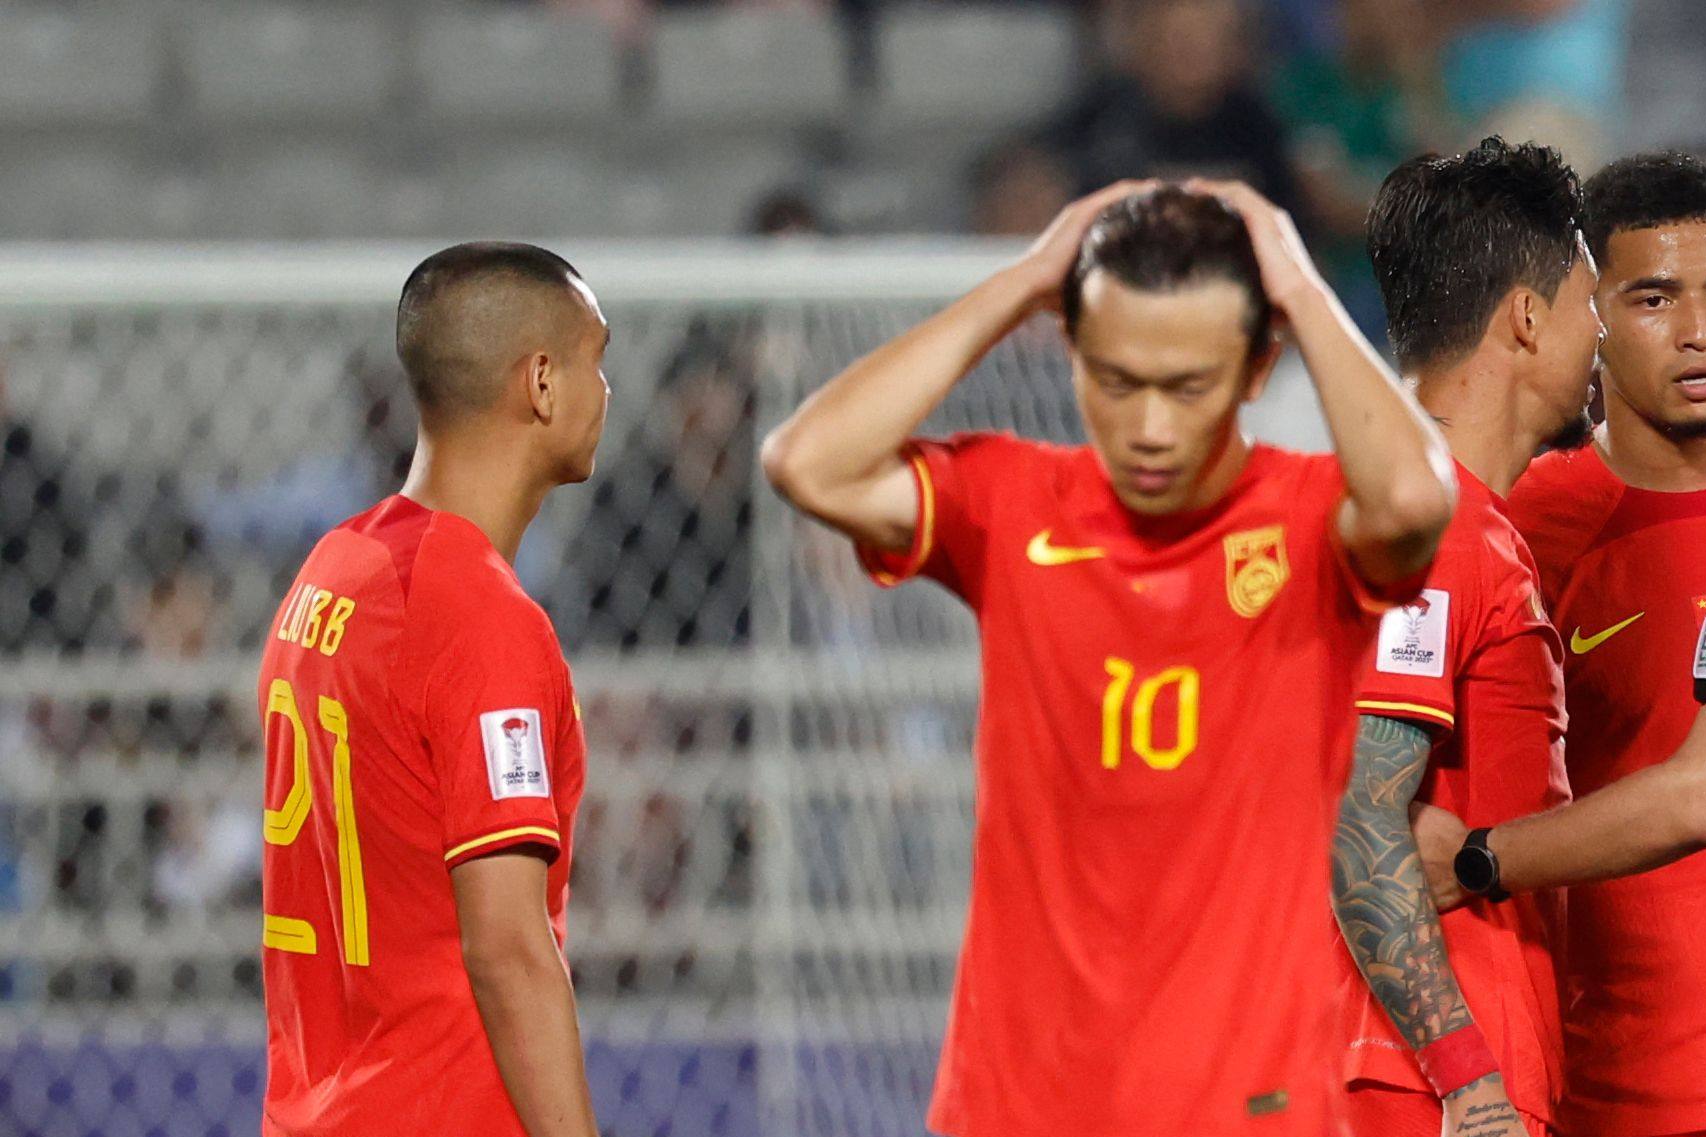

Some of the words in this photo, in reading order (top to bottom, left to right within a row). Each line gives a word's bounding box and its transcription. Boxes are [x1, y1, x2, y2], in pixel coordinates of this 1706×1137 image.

[1390, 647, 1416, 656] ASIAN
[1417, 649, 1434, 659] CUP
[1102, 656, 1199, 770] 10
[263, 678, 370, 967] 21
